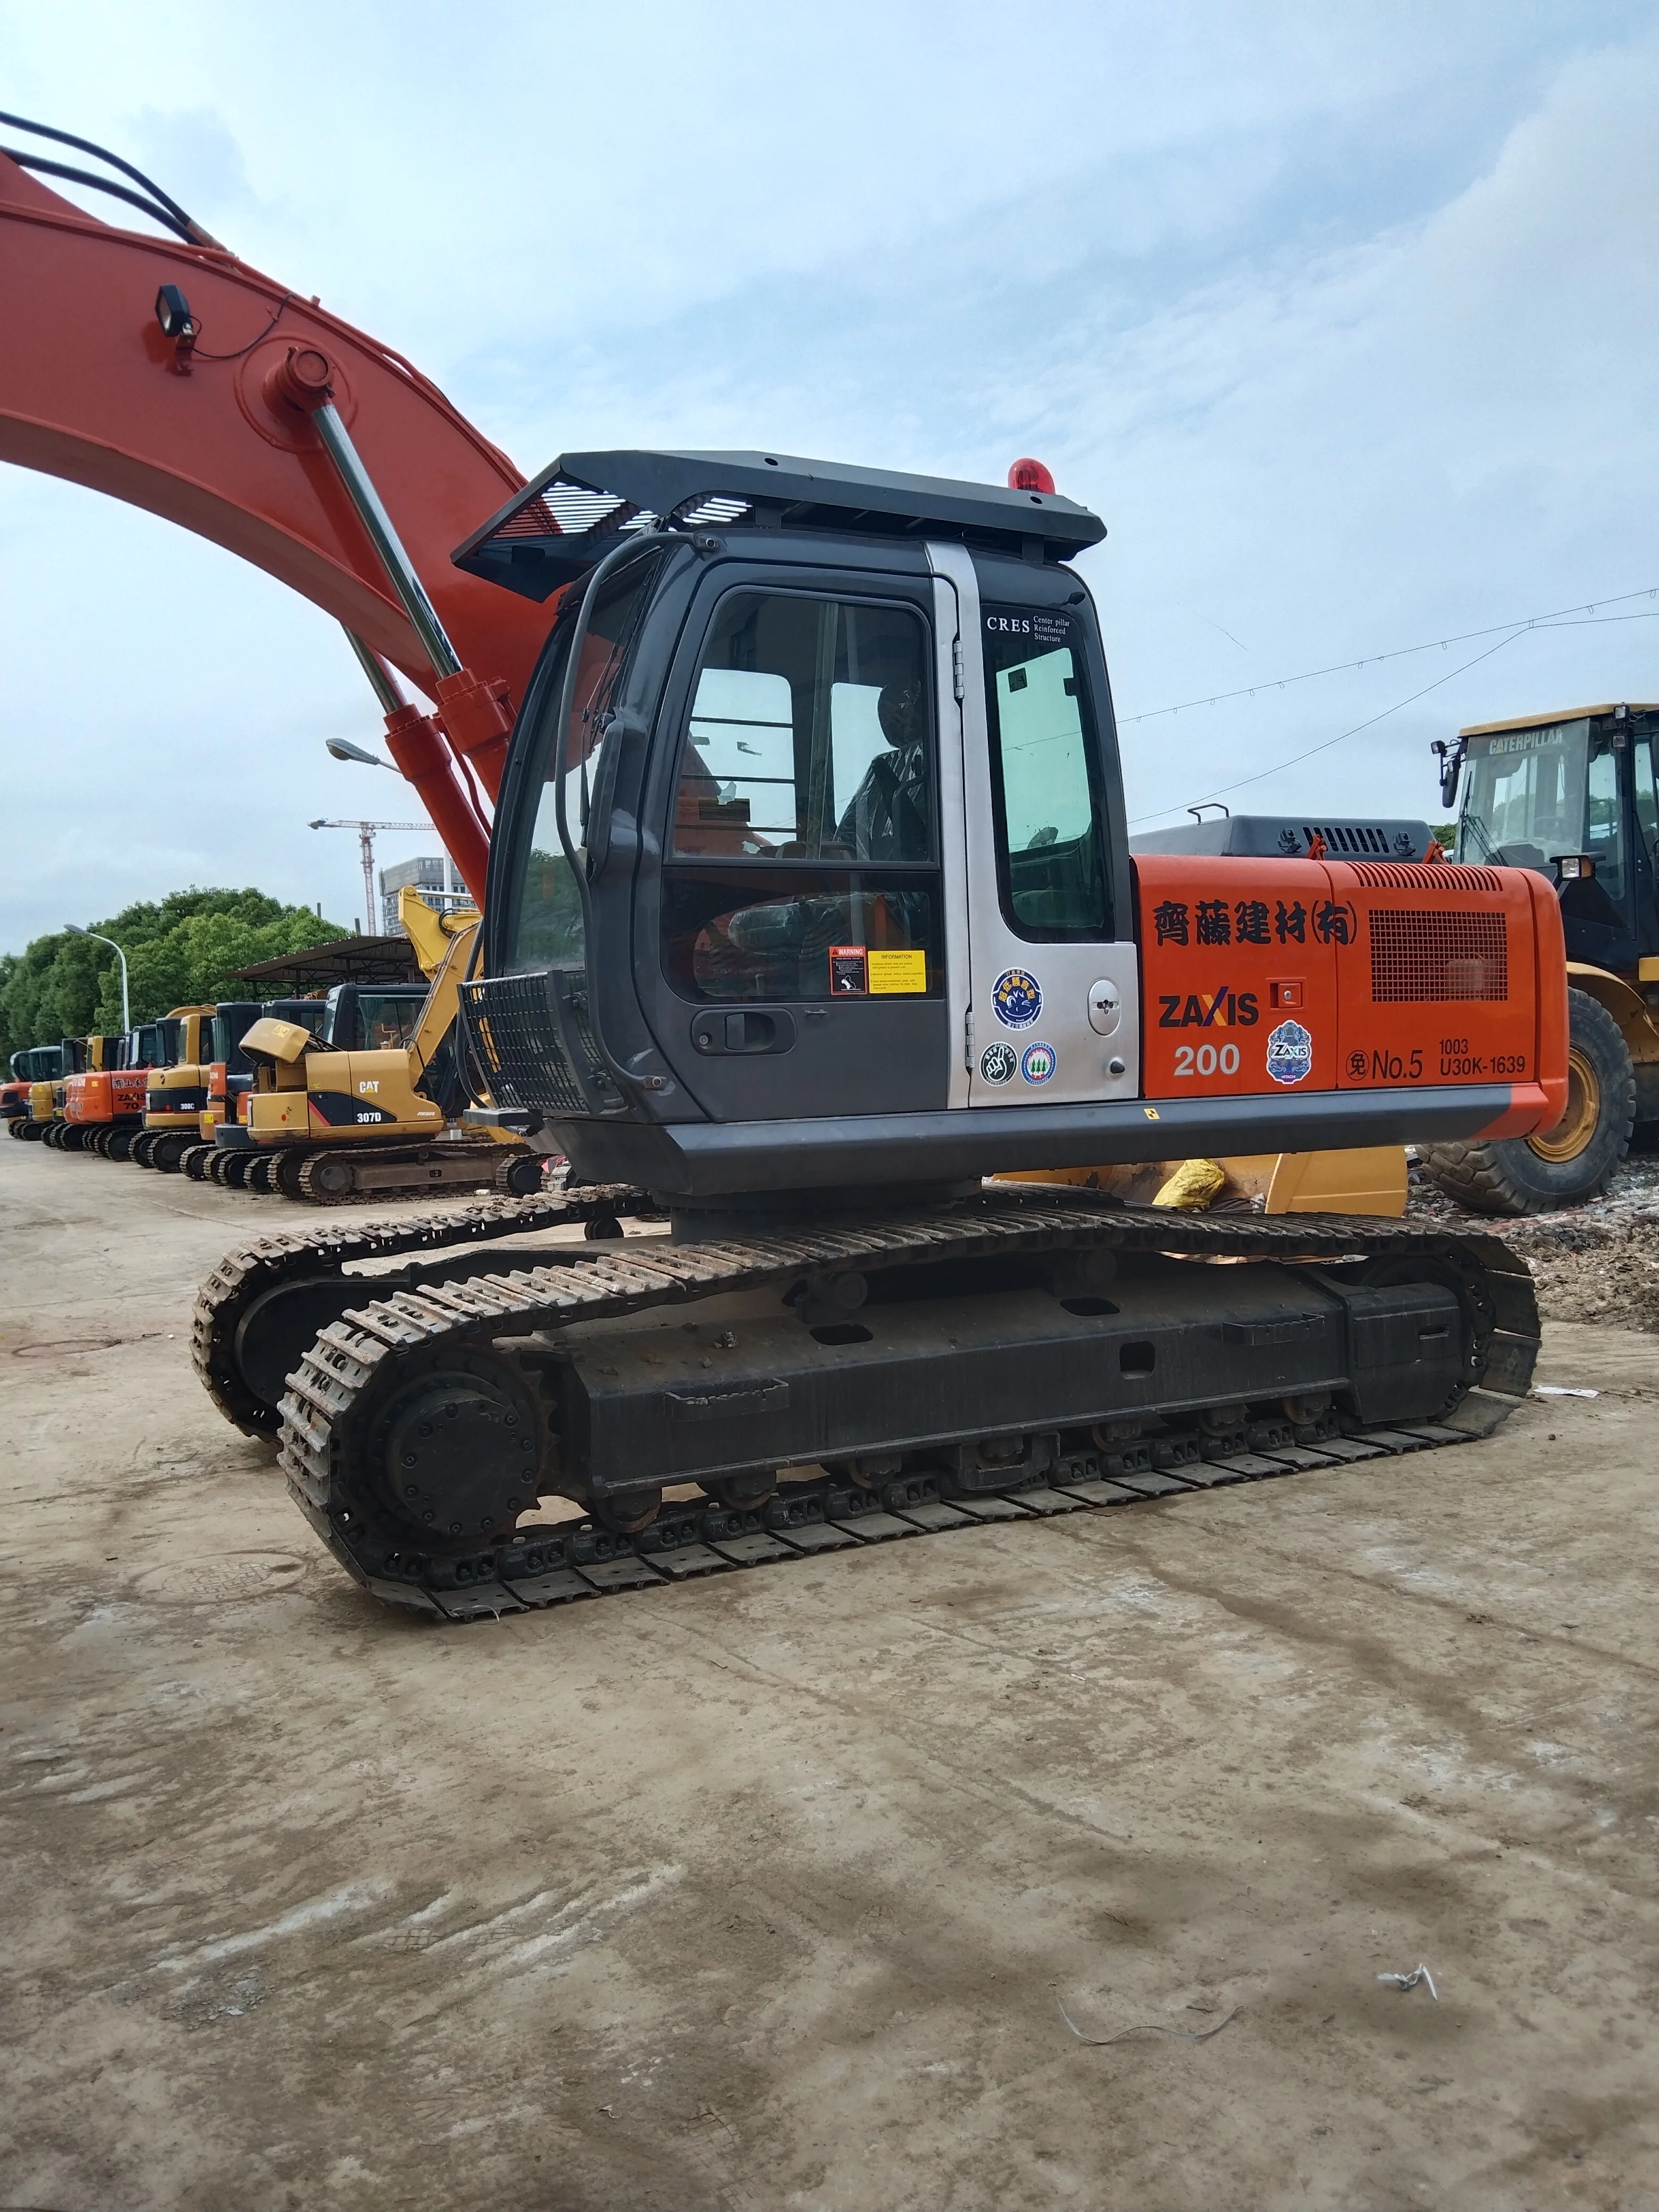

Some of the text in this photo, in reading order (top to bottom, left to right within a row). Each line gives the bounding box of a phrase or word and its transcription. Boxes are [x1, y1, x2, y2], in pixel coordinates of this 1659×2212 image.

[987, 617, 1030, 633] CRES
[1033, 615, 1070, 627] Center pillar
[1034, 624, 1066, 635] Reinforced
[1034, 633, 1061, 642] Structure
[1489, 728, 1563, 755] CATERPILLAR
[1159, 986, 1259, 1028] ZAXIS
[1274, 1044, 1307, 1057] ZAXIS
[1439, 1038, 1468, 1055] 1003
[1174, 1044, 1240, 1076] 200
[1372, 1049, 1423, 1079] No.5
[1440, 1055, 1526, 1076] U30K-1639
[359, 1081, 379, 1093] CAT
[118, 1092, 146, 1101] ZAXIS
[357, 1112, 381, 1122] 307D
